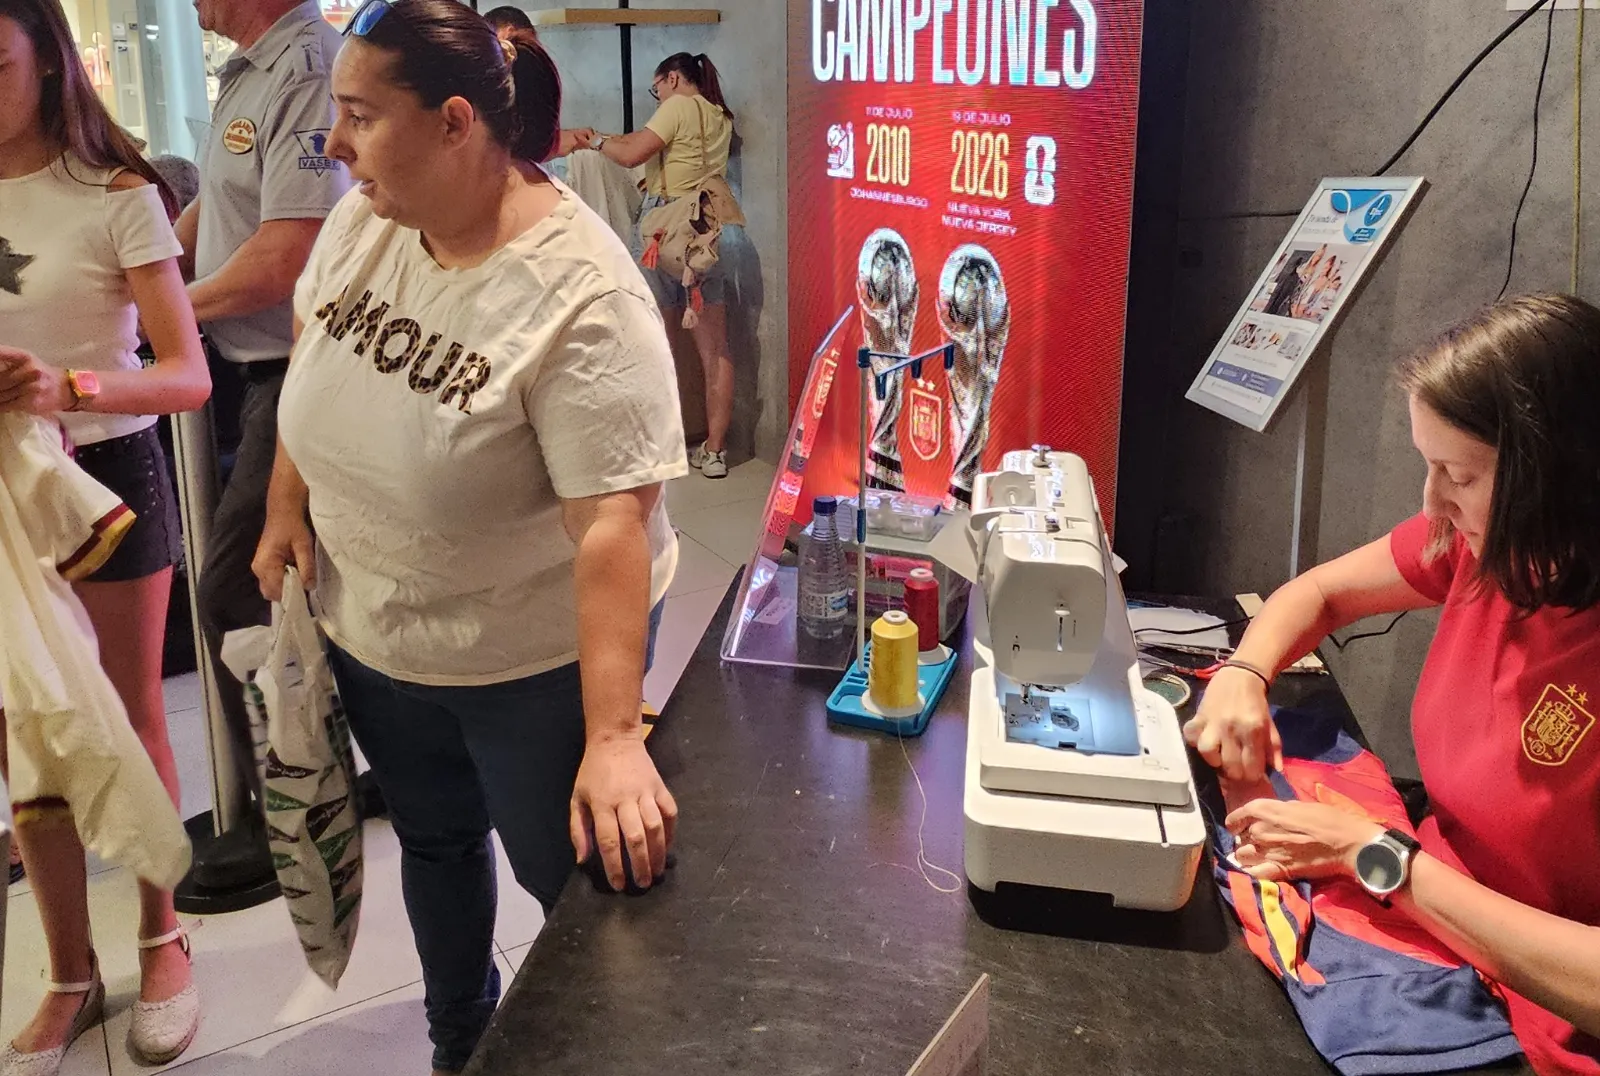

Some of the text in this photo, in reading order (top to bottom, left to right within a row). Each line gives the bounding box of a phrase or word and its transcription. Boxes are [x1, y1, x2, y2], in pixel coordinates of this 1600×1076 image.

[812, 0, 1098, 88] CAMPEONES
[866, 123, 910, 186] 2010
[951, 130, 1010, 200] 2026
[942, 215, 1017, 236] NUEVA JERSEY
[315, 280, 492, 416] AMOUR
